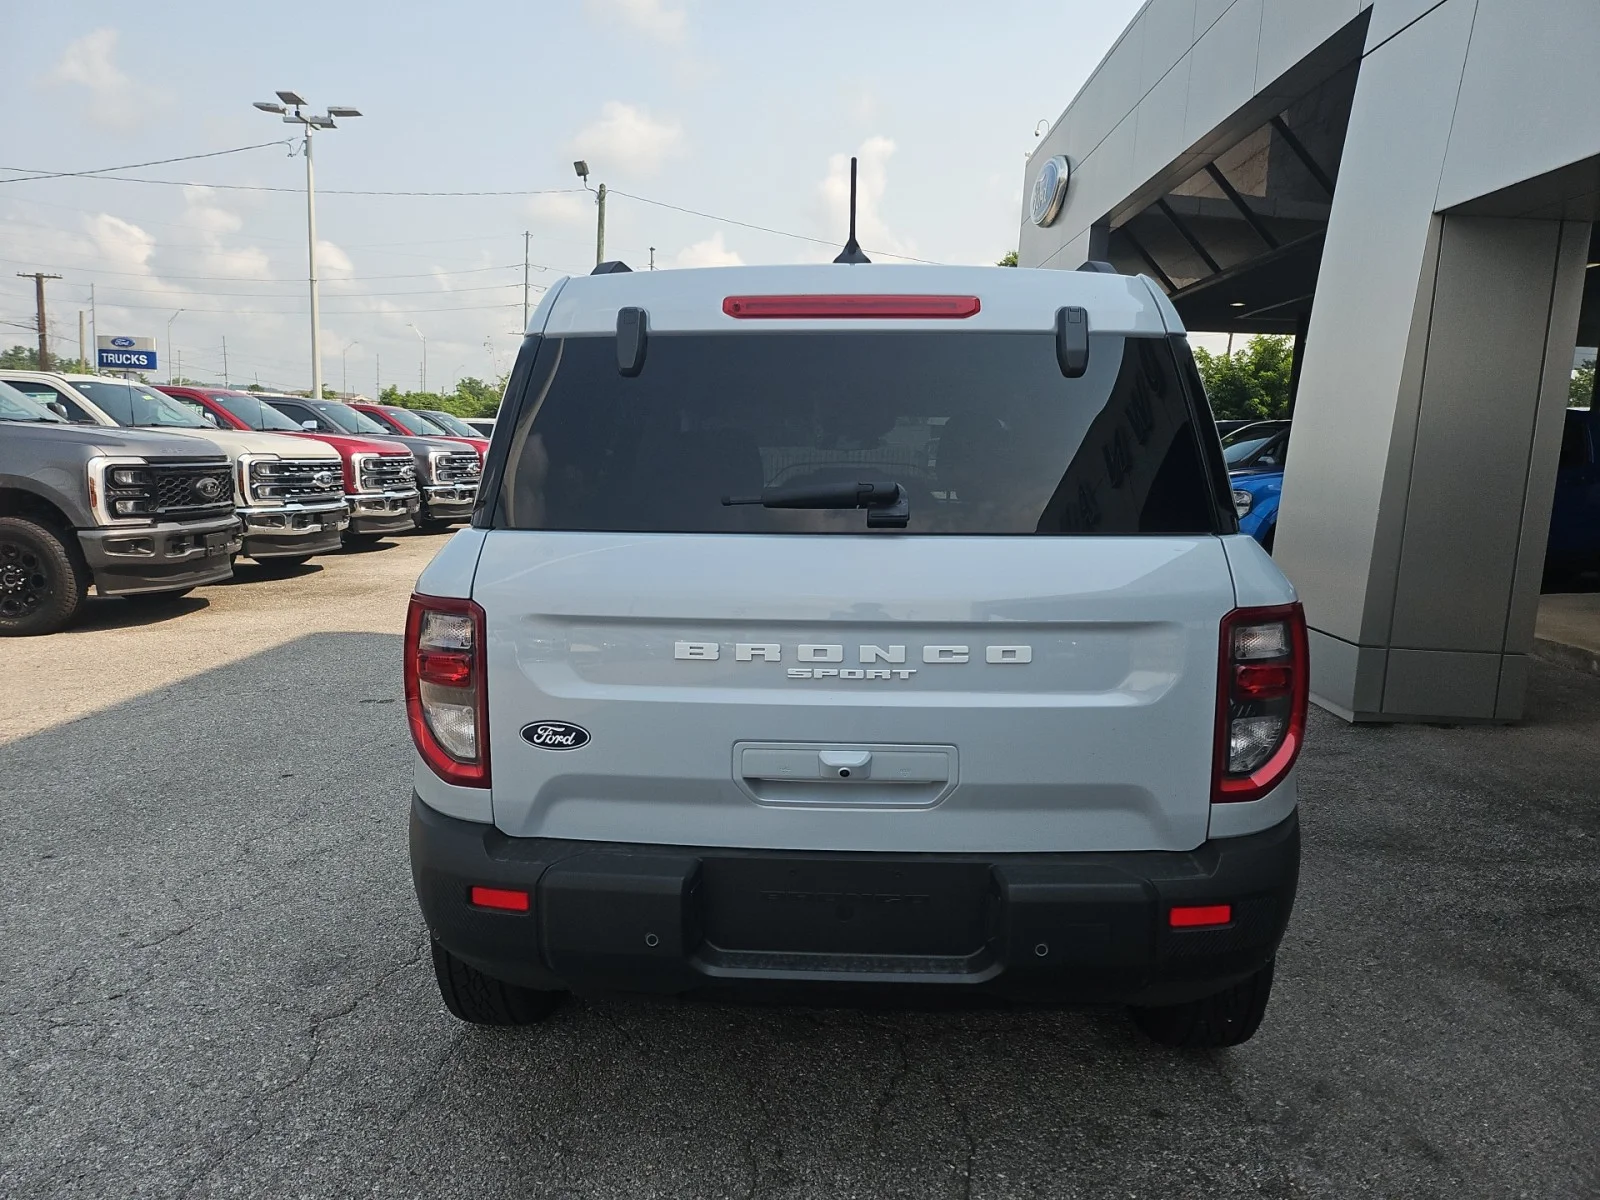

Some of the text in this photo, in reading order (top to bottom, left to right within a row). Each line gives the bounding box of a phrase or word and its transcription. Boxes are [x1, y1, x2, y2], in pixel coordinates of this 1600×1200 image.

[101, 353, 148, 365] TRUCKS
[674, 642, 1032, 664] BRONCO
[787, 668, 917, 679] SPORT
[533, 725, 576, 745] Ford
